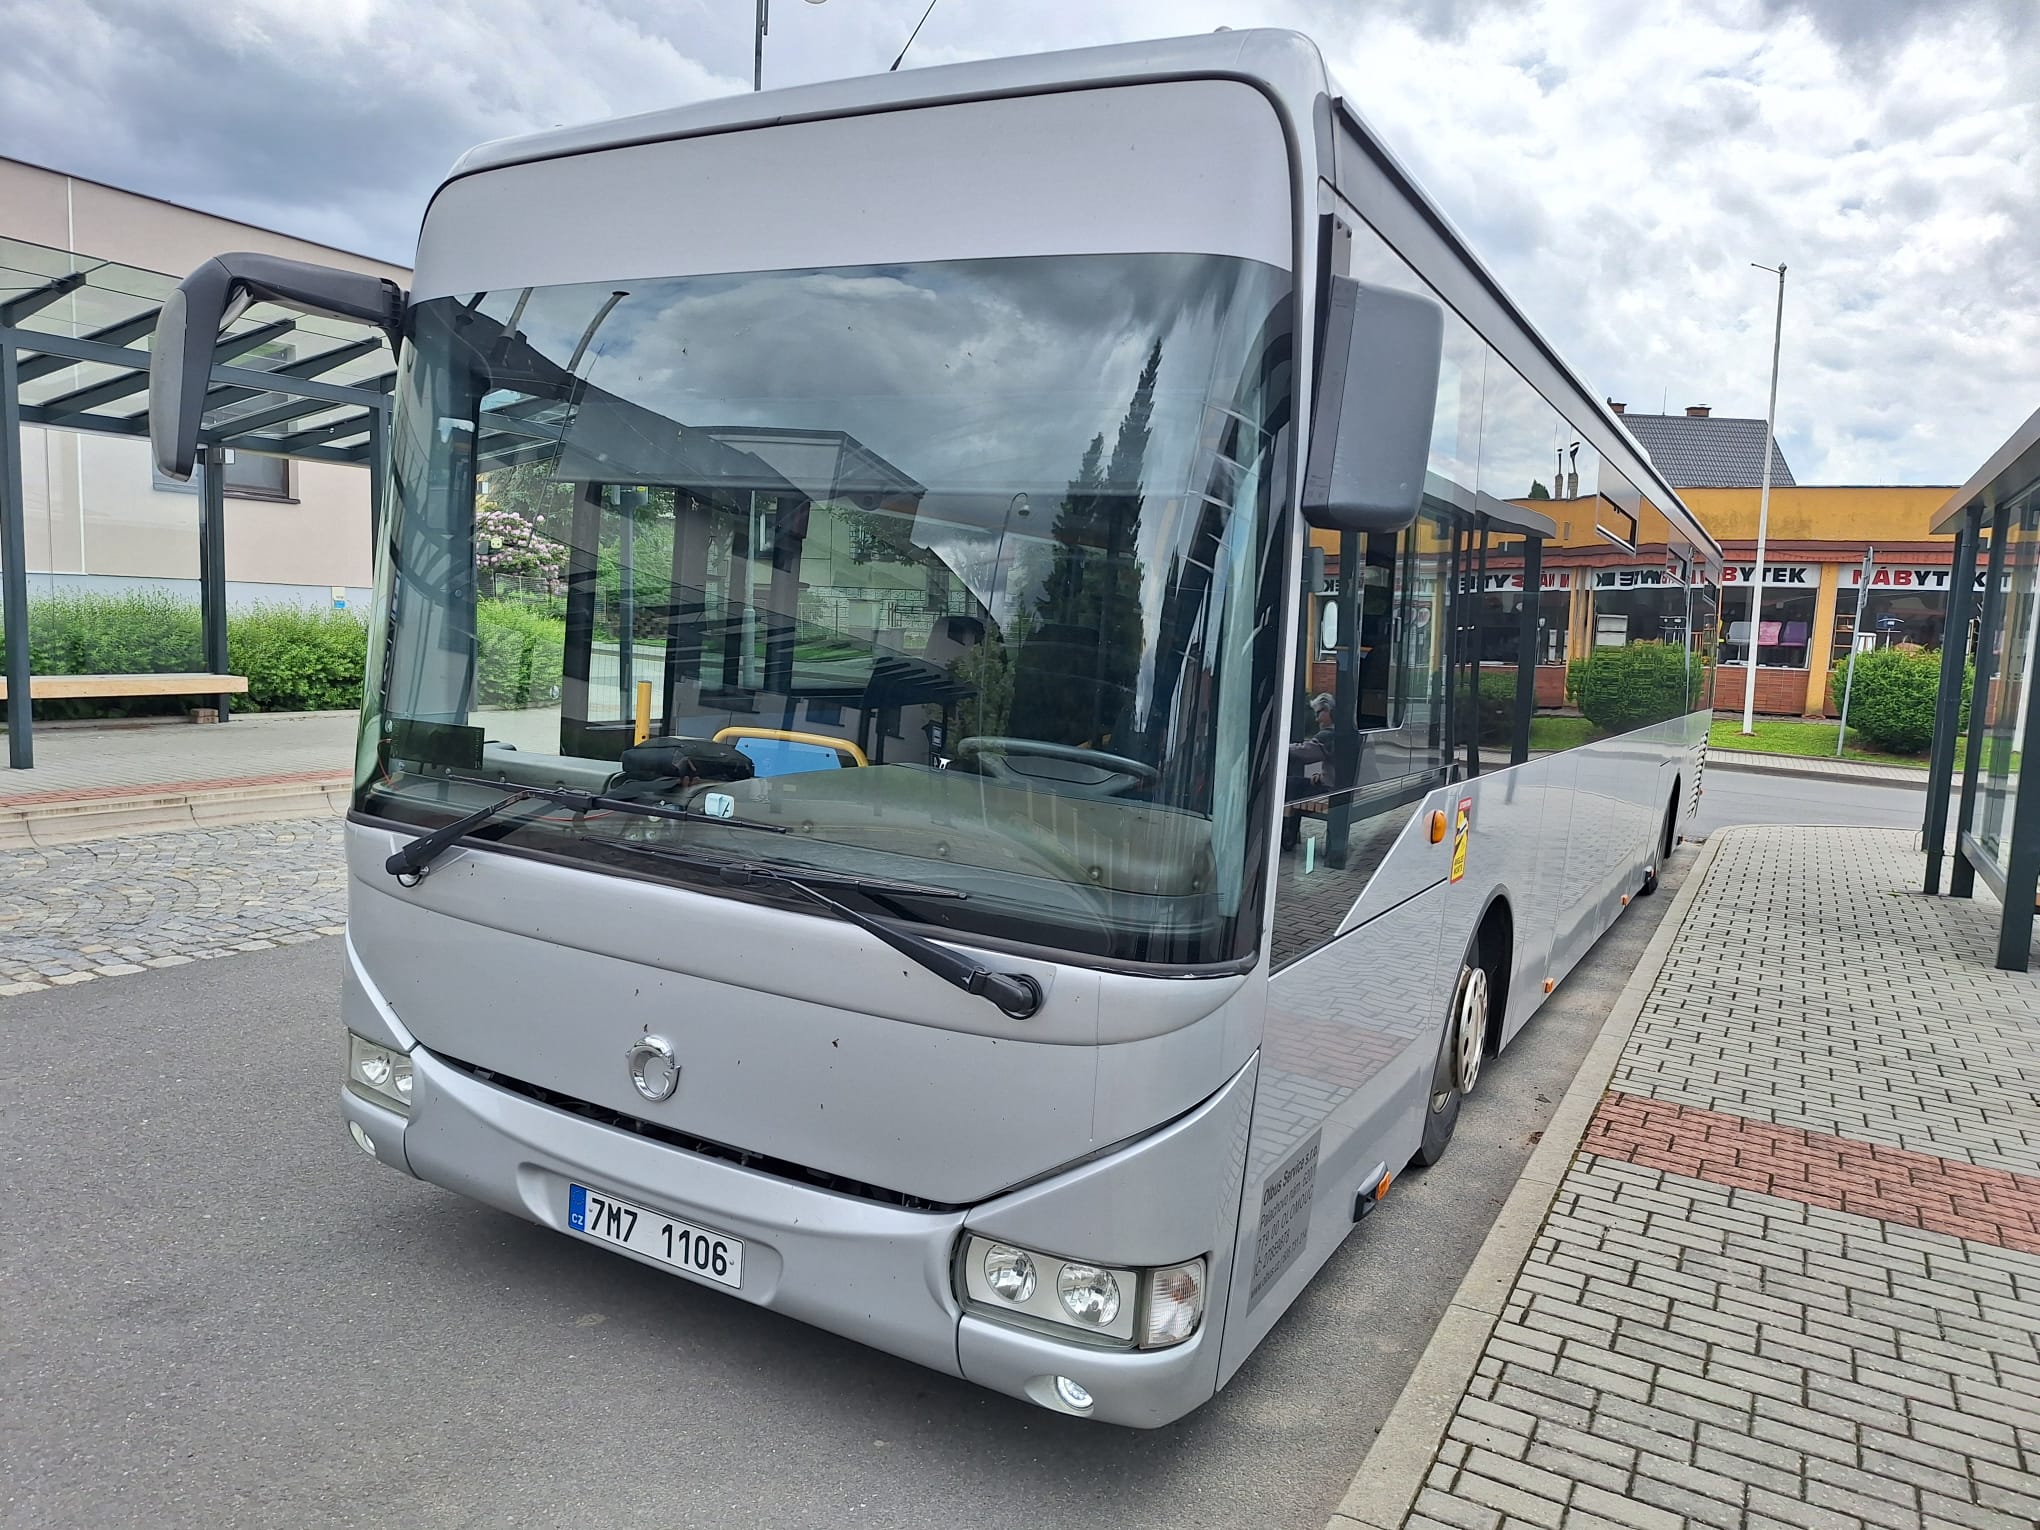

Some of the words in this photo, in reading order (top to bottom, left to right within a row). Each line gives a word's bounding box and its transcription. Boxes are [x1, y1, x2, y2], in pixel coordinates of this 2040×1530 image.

[1283, 1159, 1304, 1186] Service
[571, 1212, 584, 1226] CZ
[1281, 1184, 1314, 1229] OLOMOUC
[591, 1197, 638, 1242] 7M7
[661, 1223, 728, 1276] 1106
